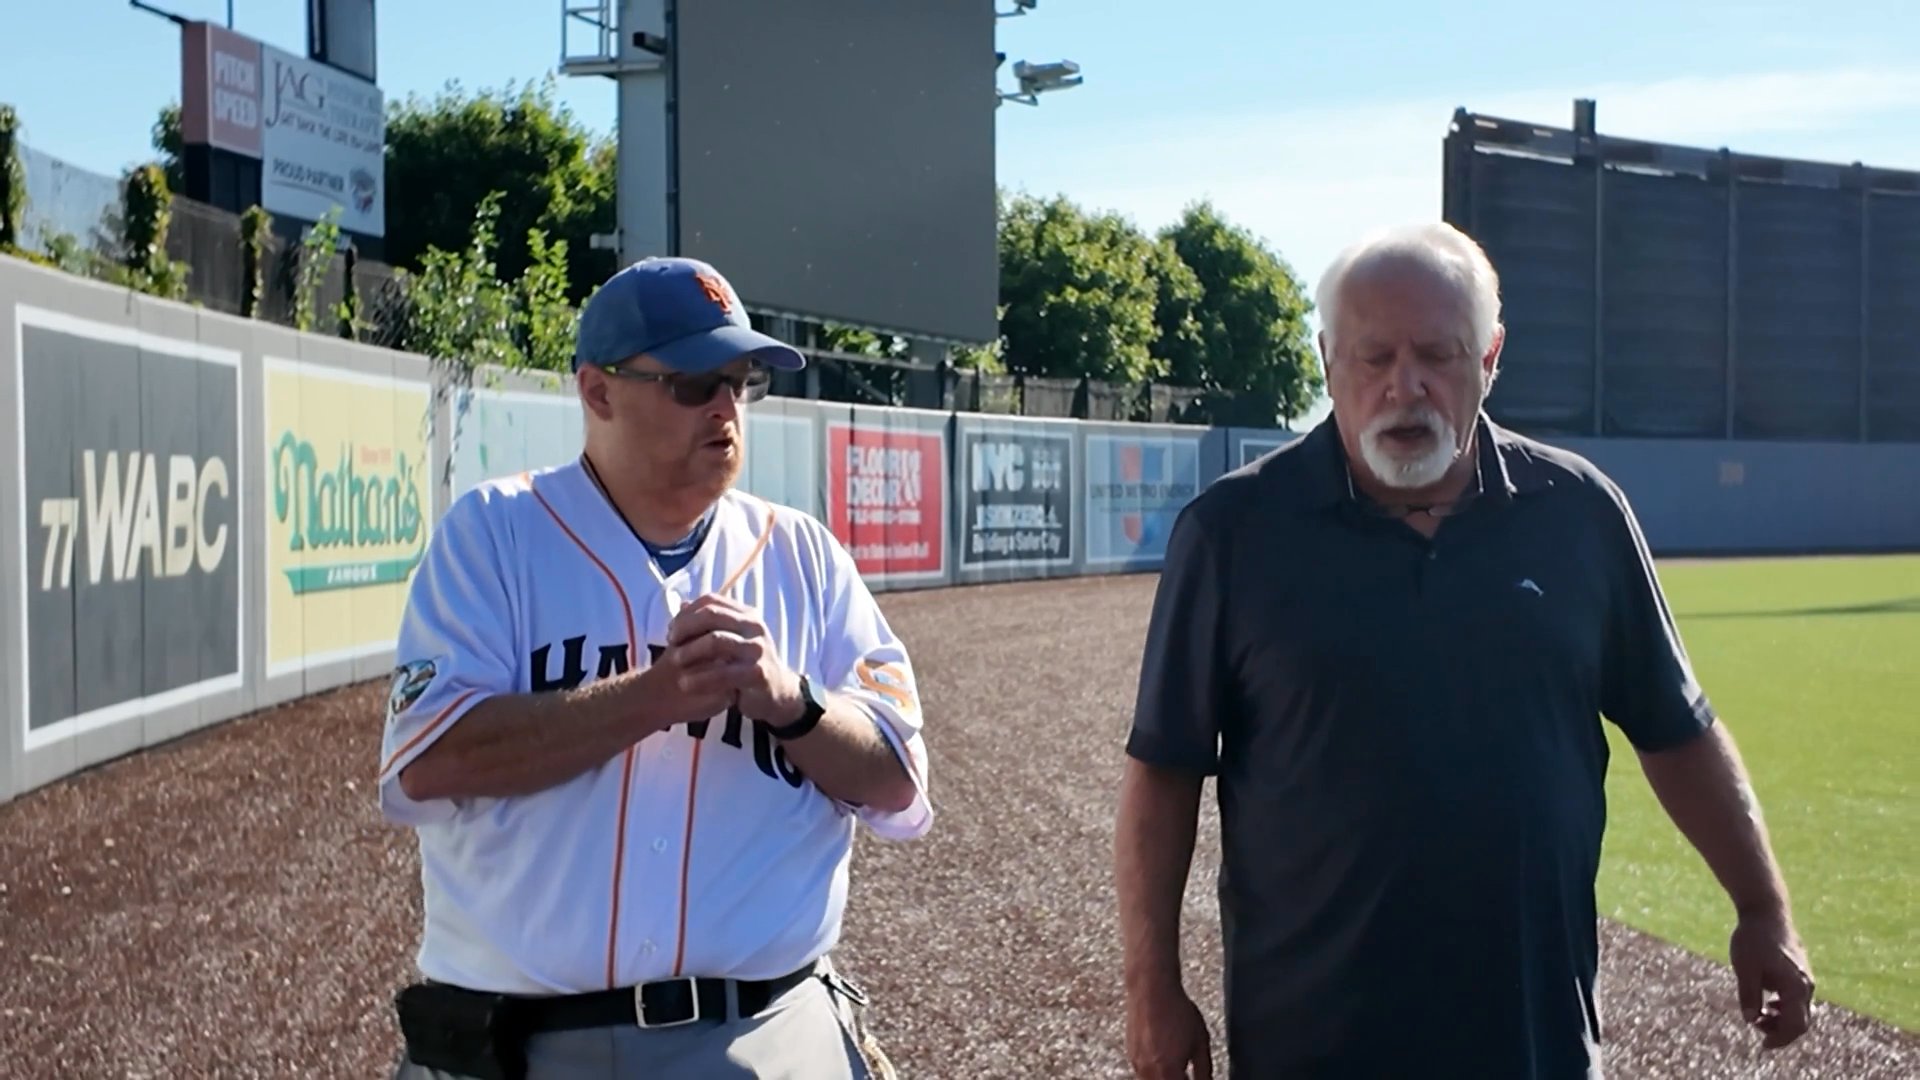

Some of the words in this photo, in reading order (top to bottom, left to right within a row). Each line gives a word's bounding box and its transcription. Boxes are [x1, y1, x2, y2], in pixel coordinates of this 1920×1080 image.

[215, 87, 257, 130] SPEED
[273, 430, 422, 552] Nathan's
[972, 443, 1024, 492] NYC
[40, 498, 79, 591] 77
[83, 449, 229, 586] WABC
[327, 563, 377, 585] FAMOUS
